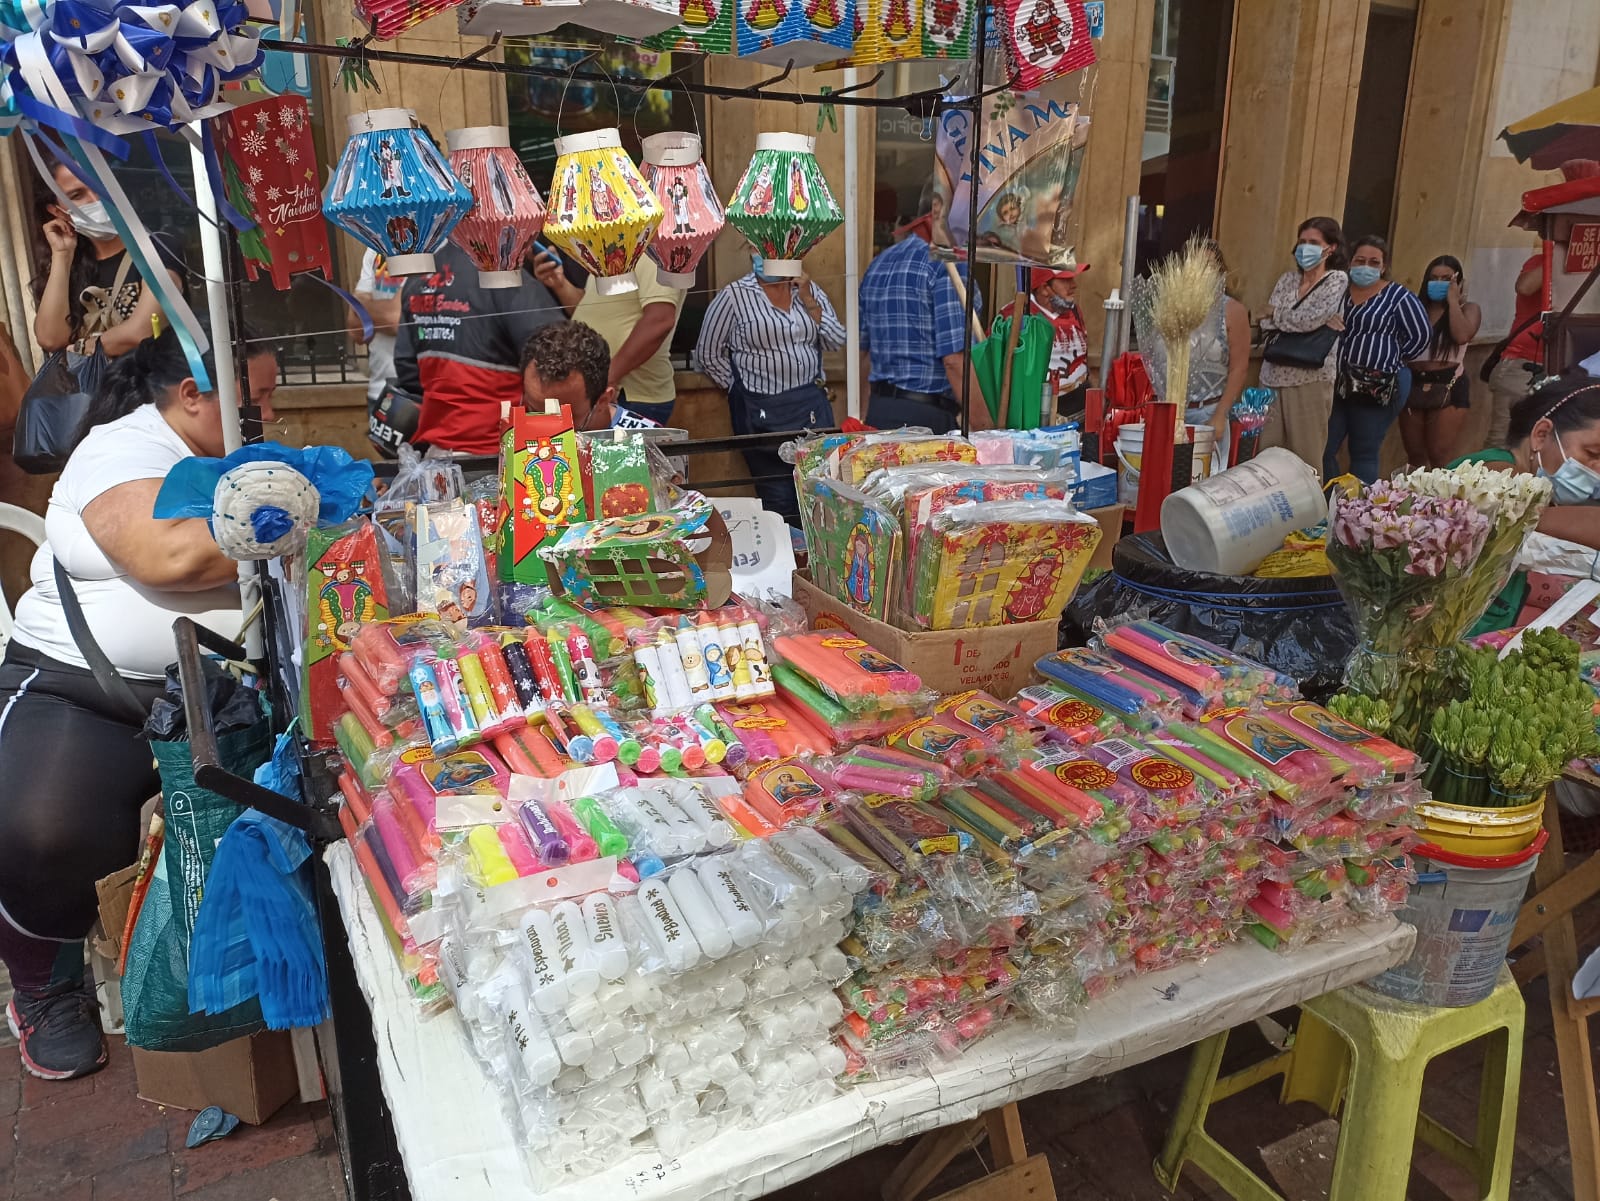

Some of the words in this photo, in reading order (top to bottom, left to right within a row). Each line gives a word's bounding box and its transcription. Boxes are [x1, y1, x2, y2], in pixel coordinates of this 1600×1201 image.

[268, 194, 317, 225] Navidad
[284, 182, 315, 206] Feliz
[1570, 241, 1595, 256] TODA
[526, 924, 549, 975] Esperanza
[556, 920, 573, 962] Vida
